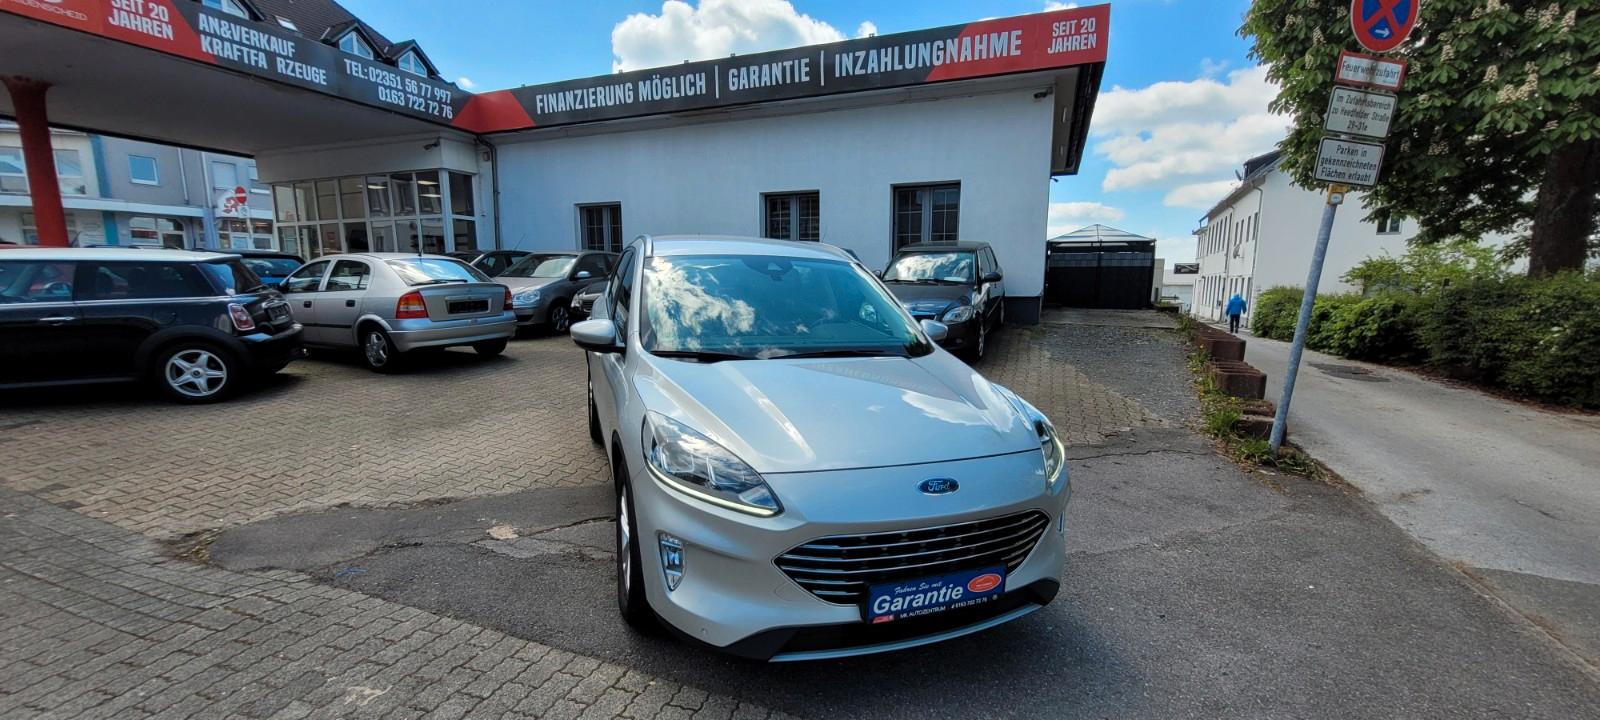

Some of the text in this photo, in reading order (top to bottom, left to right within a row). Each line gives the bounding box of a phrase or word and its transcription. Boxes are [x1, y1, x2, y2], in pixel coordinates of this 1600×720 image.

[111, 0, 169, 22] SEIT 20
[108, 8, 173, 40] JAHREN
[1052, 17, 1096, 37] SEIT 20
[198, 13, 296, 58] AN&VERKAUF
[1047, 33, 1097, 55] JAHREN
[835, 30, 1023, 77] INZAHLUNGNAHME
[728, 57, 810, 91] GARANTIE
[405, 78, 418, 94] 56
[419, 82, 431, 98] 77
[434, 87, 452, 103] 997
[535, 71, 707, 114] FINANZIERUNG MÖGLICH
[378, 86, 453, 119] 0163 722 72 76
[1345, 94, 1391, 110] Zufahrtsbereich
[1371, 111, 1389, 122] Straße
[1336, 145, 1368, 157] Parken in
[1320, 156, 1377, 171] gekennzeichneten
[1321, 167, 1371, 183] Flächen erlaubt
[928, 480, 950, 491] Ford
[873, 584, 963, 614] Garantie
[895, 586, 917, 595] Fahren
[918, 582, 930, 590] Sie
